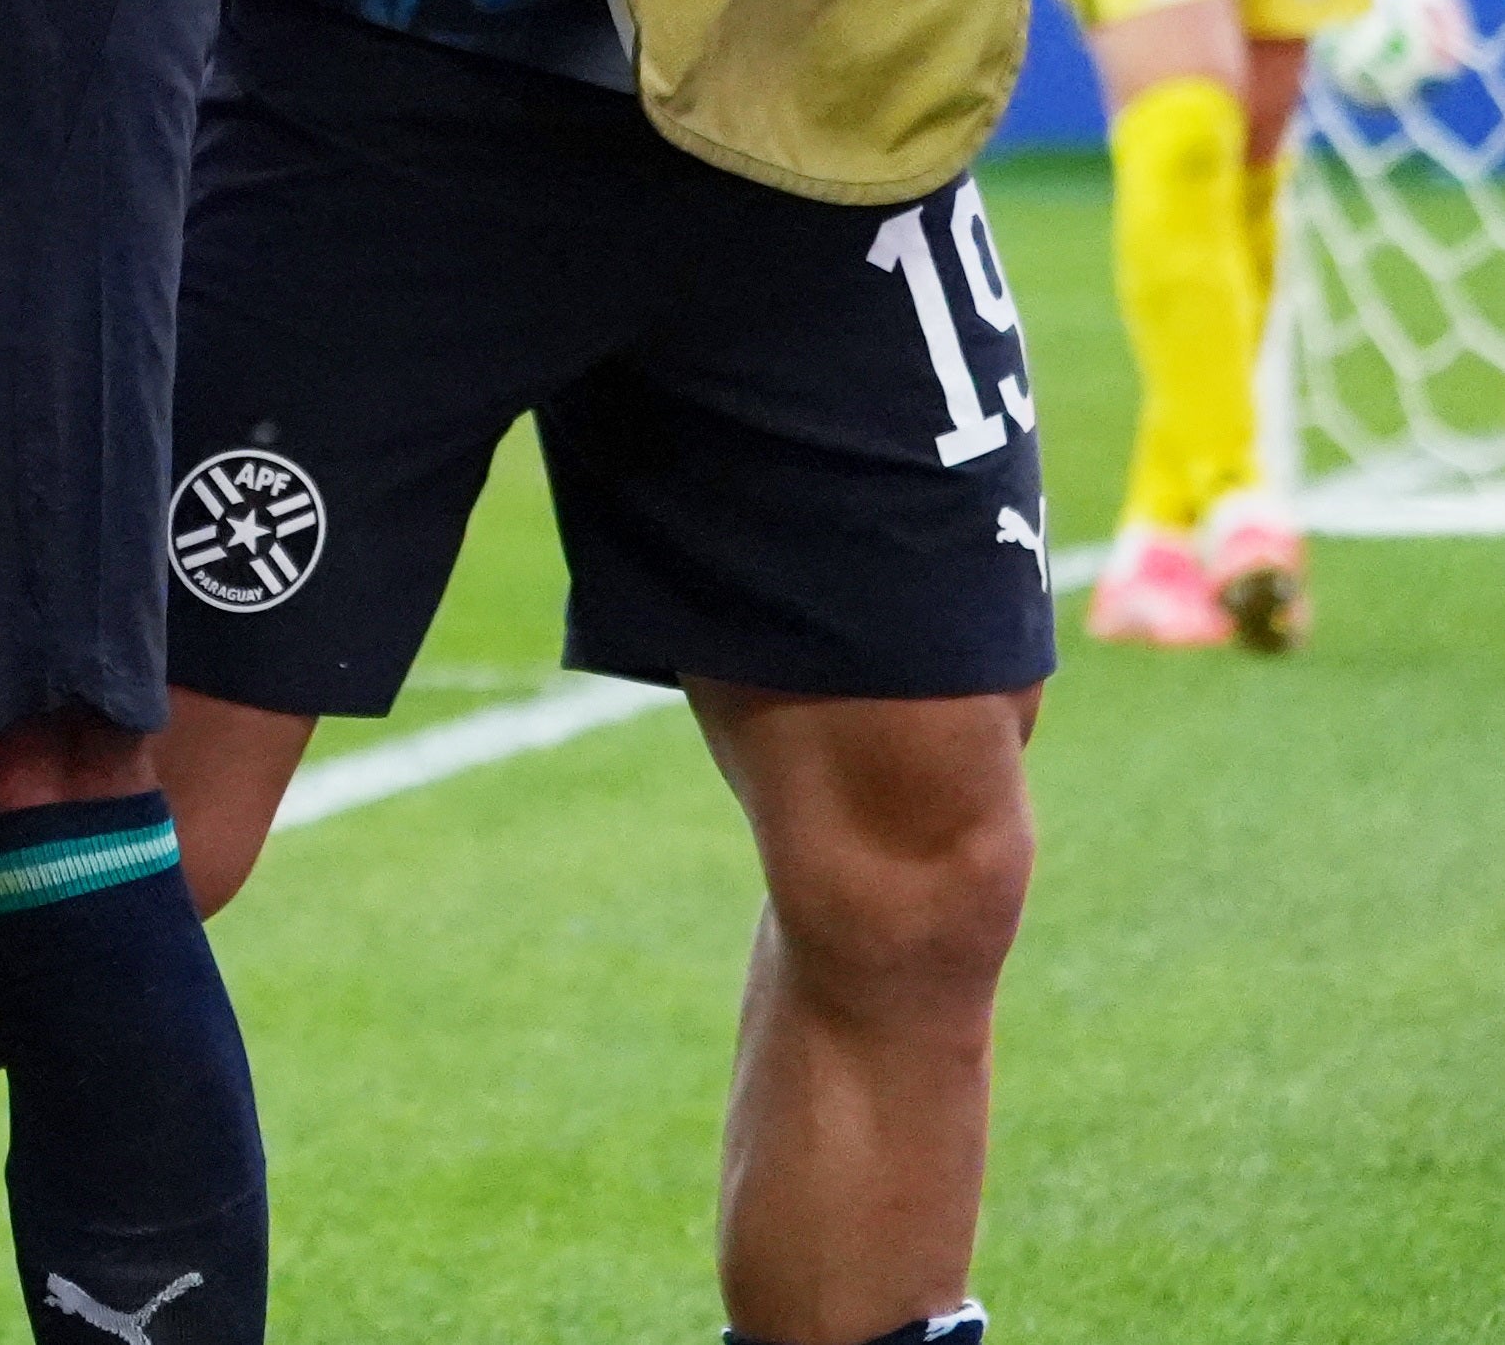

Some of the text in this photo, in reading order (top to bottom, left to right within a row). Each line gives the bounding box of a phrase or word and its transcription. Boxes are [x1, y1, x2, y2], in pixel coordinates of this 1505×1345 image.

[865, 177, 1036, 468] 19
[233, 462, 292, 497] APF
[192, 570, 264, 603] PARAGUAY
